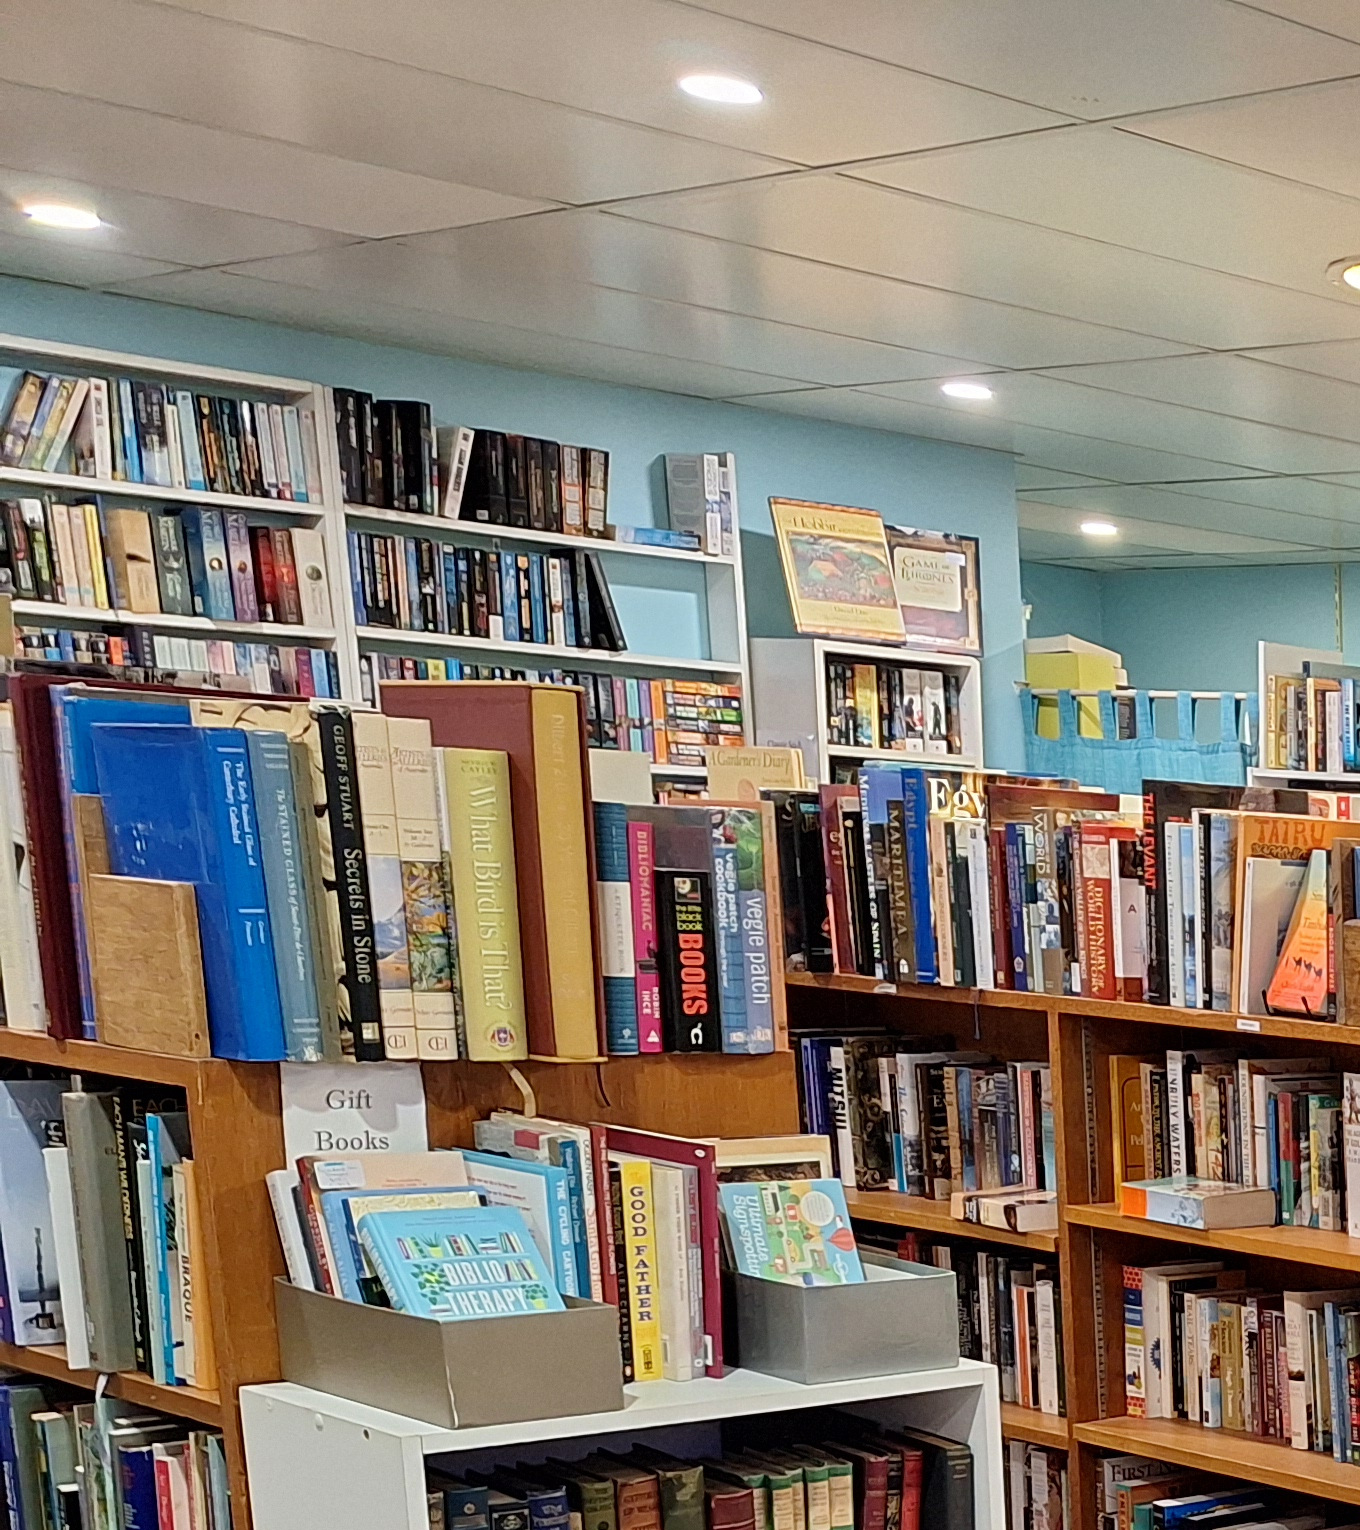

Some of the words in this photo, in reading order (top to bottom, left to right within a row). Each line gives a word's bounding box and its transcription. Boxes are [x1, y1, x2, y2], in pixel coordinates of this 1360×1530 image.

[332, 724, 349, 771] GEOFF
[338, 775, 355, 829] STUART
[469, 785, 499, 852] What
[1143, 793, 1155, 823] THE
[344, 849, 364, 910] Secrets
[636, 831, 652, 932] BIBLIOMANIAC
[1145, 828, 1157, 889] LEVANT
[472, 862, 502, 911] Bird
[351, 915, 364, 931] in
[479, 916, 500, 941] is
[677, 911, 702, 922] black
[678, 921, 702, 931] book
[742, 897, 765, 947] vegie
[353, 936, 372, 984] Stone
[482, 946, 512, 1011] That?
[678, 933, 708, 1015] BOOKS
[746, 952, 769, 1004] patch
[327, 1090, 372, 1109] Gift
[1168, 1068, 1181, 1121] UNRULY
[316, 1131, 390, 1151] Books
[1170, 1122, 1182, 1176] WATERS
[630, 1186, 647, 1237] GOOD
[181, 1254, 192, 1323] BRAQUE
[444, 1261, 506, 1286] BIBLIO
[634, 1245, 653, 1322] FATHER
[449, 1288, 528, 1314] THERAPY
